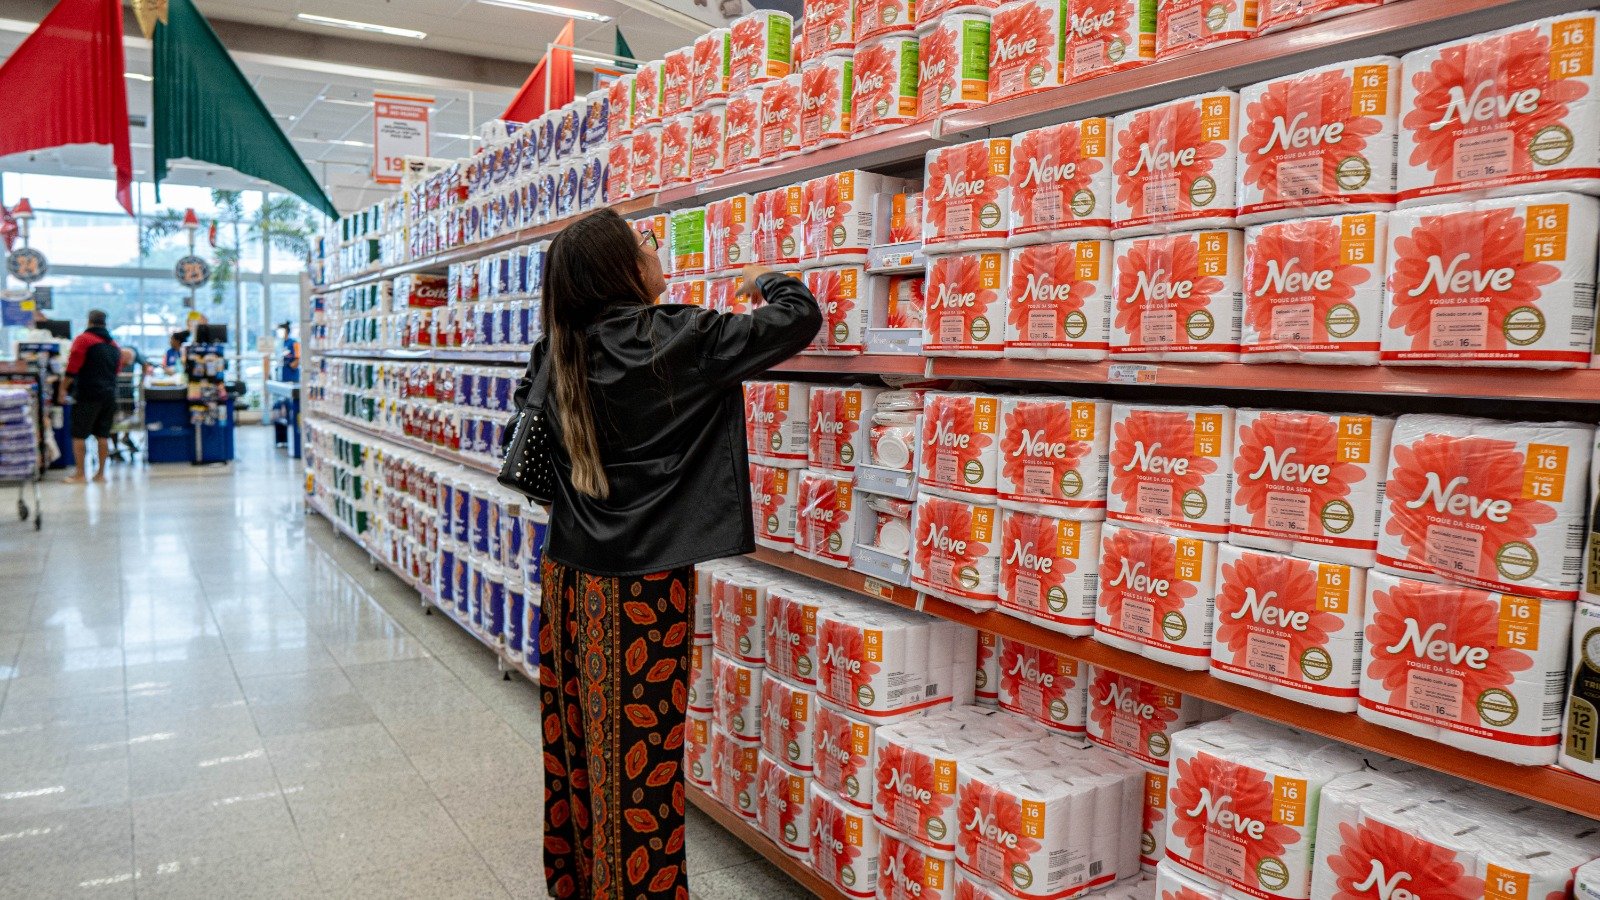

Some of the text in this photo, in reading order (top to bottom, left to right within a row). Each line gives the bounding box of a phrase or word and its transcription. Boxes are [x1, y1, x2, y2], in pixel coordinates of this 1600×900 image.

[1068, 7, 1115, 37] Neve
[1561, 29, 1584, 45] 16
[990, 34, 1037, 67] Neve
[918, 54, 945, 84] Neve
[1559, 59, 1581, 74] 15
[1361, 75, 1379, 88] 16
[1208, 105, 1223, 116] 16
[1359, 99, 1377, 112] 15
[1430, 79, 1541, 131] Neve
[1087, 125, 1100, 135] 16
[1207, 126, 1221, 137] 15
[1258, 112, 1345, 155] Neve
[994, 146, 1007, 155] 16
[1086, 145, 1099, 155] 15
[1128, 138, 1196, 176] Neve
[993, 163, 1004, 173] 15
[1020, 155, 1076, 189] Neve
[842, 176, 849, 185] 16
[936, 174, 985, 201] Neve
[841, 191, 848, 199] 15
[802, 201, 835, 224] Neve
[1536, 215, 1558, 229] 16
[1349, 223, 1367, 237] 16
[1205, 240, 1221, 251] 16
[1532, 242, 1554, 258] 15
[1081, 248, 1094, 259] 16
[1347, 247, 1364, 260] 15
[985, 259, 995, 269] 16
[1203, 261, 1219, 273] 15
[1080, 268, 1092, 278] 15
[1255, 257, 1334, 297] Neve
[1408, 252, 1515, 297] Neve
[983, 277, 994, 287] 15
[1018, 273, 1071, 302] Neve
[1126, 269, 1193, 303] Neve
[931, 282, 975, 311] Neve
[979, 403, 991, 413] 16
[1076, 408, 1089, 419] 16
[813, 411, 843, 434] Neve
[978, 420, 989, 431] 15
[1201, 421, 1214, 433] 16
[1346, 422, 1363, 436] 16
[928, 420, 970, 449] Neve
[1075, 427, 1087, 438] 15
[1012, 429, 1066, 459] Neve
[1199, 442, 1212, 453] 15
[1124, 441, 1189, 476] Neve
[1344, 447, 1360, 460] 15
[1249, 446, 1330, 485] Neve
[1536, 455, 1558, 470] 16
[1532, 481, 1552, 498] 15
[1406, 472, 1512, 523] Neve
[977, 513, 988, 523] 16
[1426, 516, 1450, 524] TOQUE
[1465, 522, 1487, 531] SEDA
[922, 523, 966, 552] Neve
[975, 529, 985, 540] 15
[1062, 526, 1074, 537] 16
[1006, 538, 1053, 574] Neve
[1060, 545, 1072, 555] 15
[1182, 546, 1196, 557] 16
[1110, 558, 1169, 597] Neve
[1180, 567, 1192, 578] 15
[1325, 573, 1342, 587] 16
[1231, 587, 1309, 631] Neve
[1322, 596, 1338, 608] 15
[1508, 604, 1530, 619] 16
[868, 636, 878, 645] 16
[1386, 617, 1488, 670] Neve
[1506, 630, 1527, 645] 15
[823, 643, 861, 674] Neve
[866, 651, 877, 660] 15
[1009, 653, 1054, 688] Neve
[1061, 664, 1071, 674] 15
[1406, 661, 1431, 670] TOQUE
[1445, 668, 1467, 677] SEDA
[1101, 680, 1154, 719] Neve
[1162, 695, 1174, 705] 15
[1573, 712, 1590, 728] 12
[855, 729, 864, 739] 16
[819, 732, 849, 764] Neve
[854, 743, 863, 753] 15
[1573, 735, 1587, 750] 11
[939, 766, 950, 776] 16
[886, 768, 932, 804] Neve
[937, 782, 949, 791] 15
[1281, 787, 1298, 799] 16
[1026, 807, 1039, 817] 16
[1187, 787, 1265, 840] Neve
[1279, 809, 1295, 822] 15
[965, 807, 1018, 849] Neve
[1025, 825, 1037, 835] 15
[929, 862, 939, 871] 16
[886, 855, 921, 897] Neve
[927, 877, 938, 887] 15
[1496, 878, 1517, 894] 16
